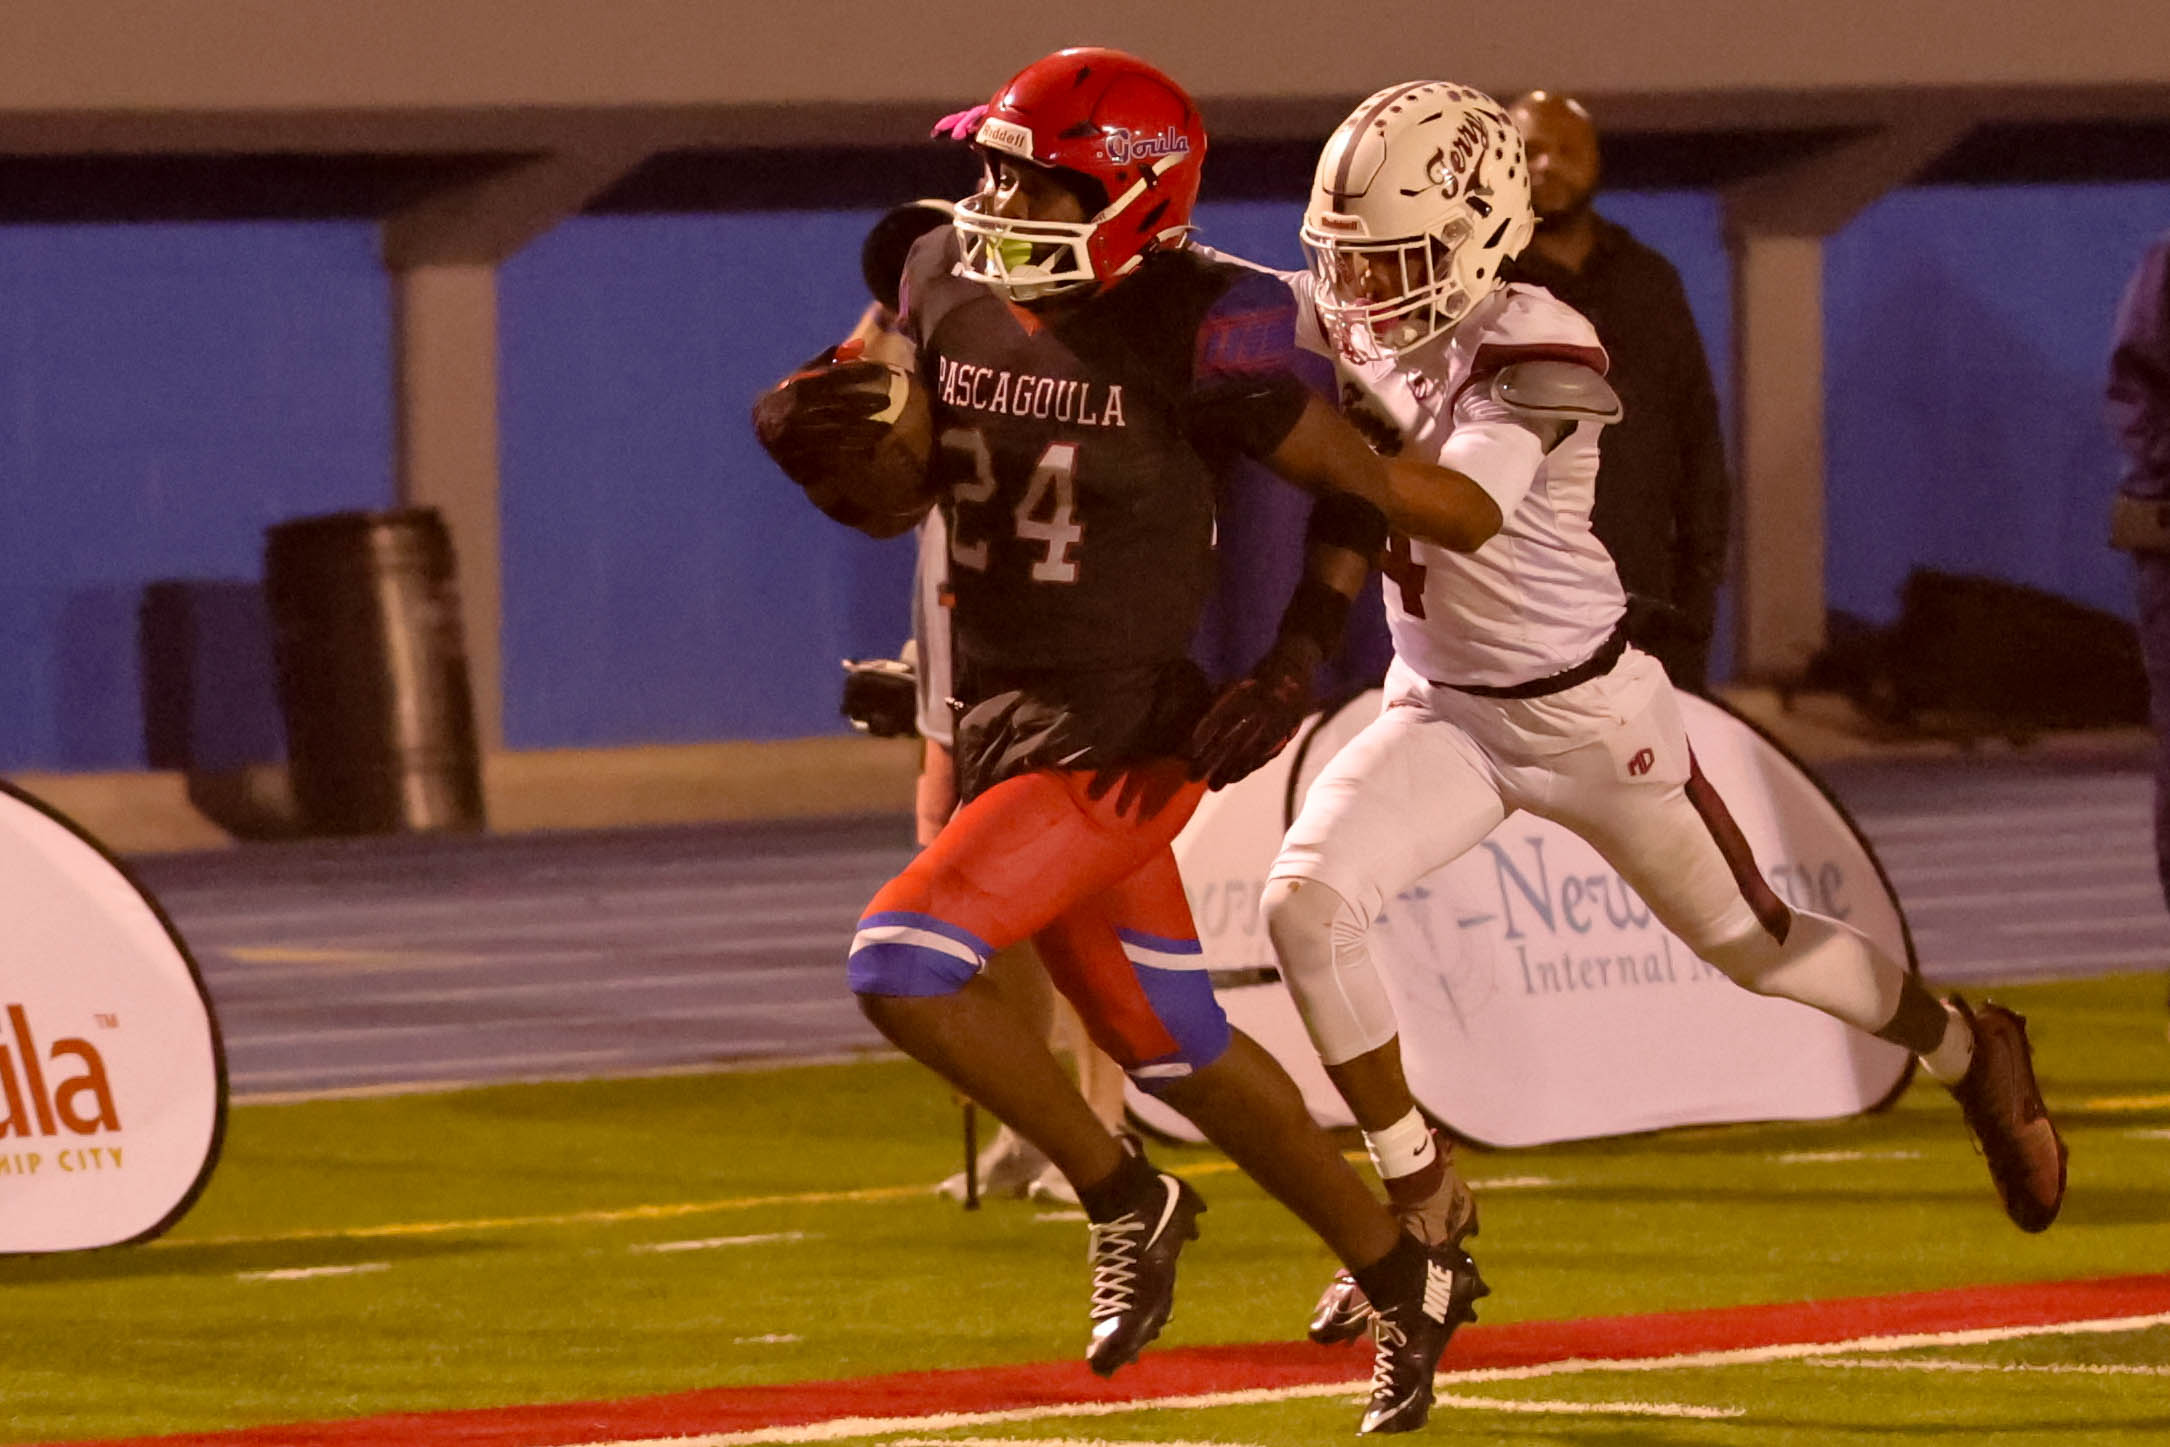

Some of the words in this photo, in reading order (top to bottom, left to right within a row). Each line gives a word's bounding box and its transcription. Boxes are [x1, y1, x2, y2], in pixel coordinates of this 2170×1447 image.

[983, 124, 1025, 148] Riddell
[939, 355, 1126, 427] PASCAGOULA
[940, 427, 1086, 583] 24
[1515, 933, 1677, 995] Internal
[58, 1147, 123, 1173] CITY
[1421, 1259, 1454, 1325] NIKE
